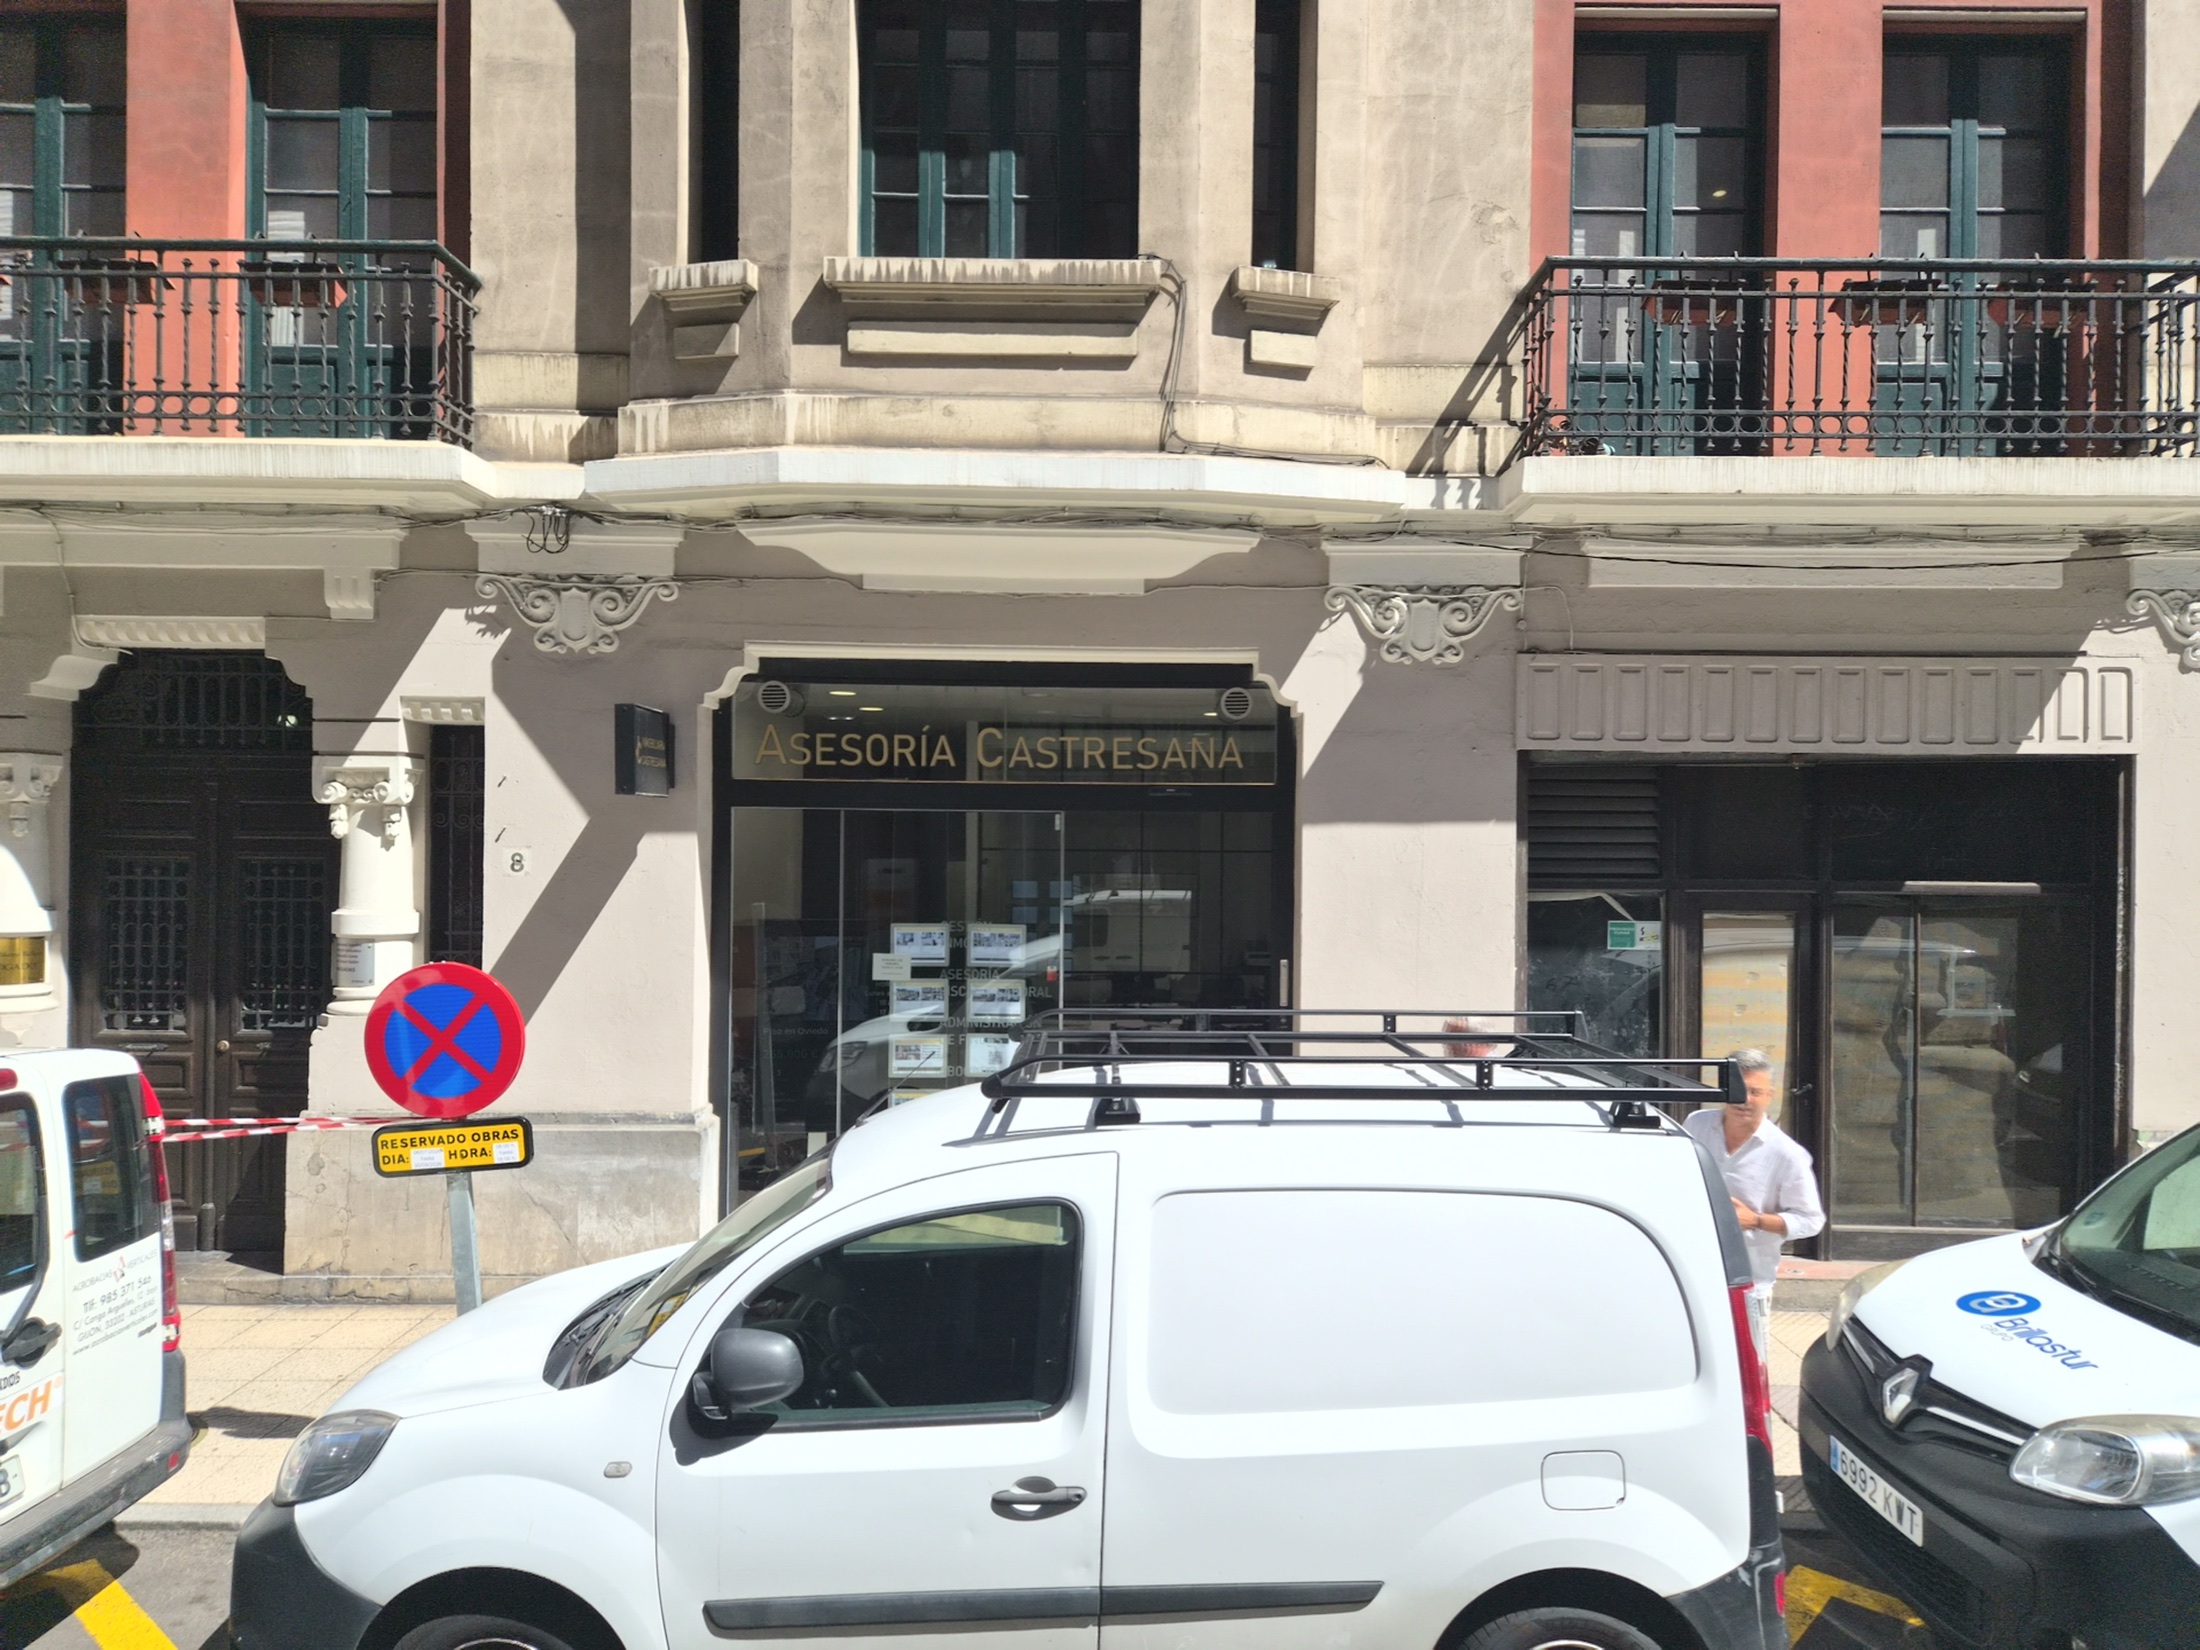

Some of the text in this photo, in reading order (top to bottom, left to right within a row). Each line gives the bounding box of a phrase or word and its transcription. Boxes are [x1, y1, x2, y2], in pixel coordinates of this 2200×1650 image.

[754, 723, 956, 768] ASESORÍA
[510, 852, 525, 872] 8
[797, 1026, 828, 1035] Oviedo
[380, 1129, 519, 1150] RESERVADO OBRAS
[382, 1147, 492, 1165] DIA: HORA:
[100, 1289, 118, 1306] 985
[120, 1281, 134, 1297] 371
[1980, 1323, 2014, 1342] GRUPO
[1840, 1450, 1877, 1504] 6992
